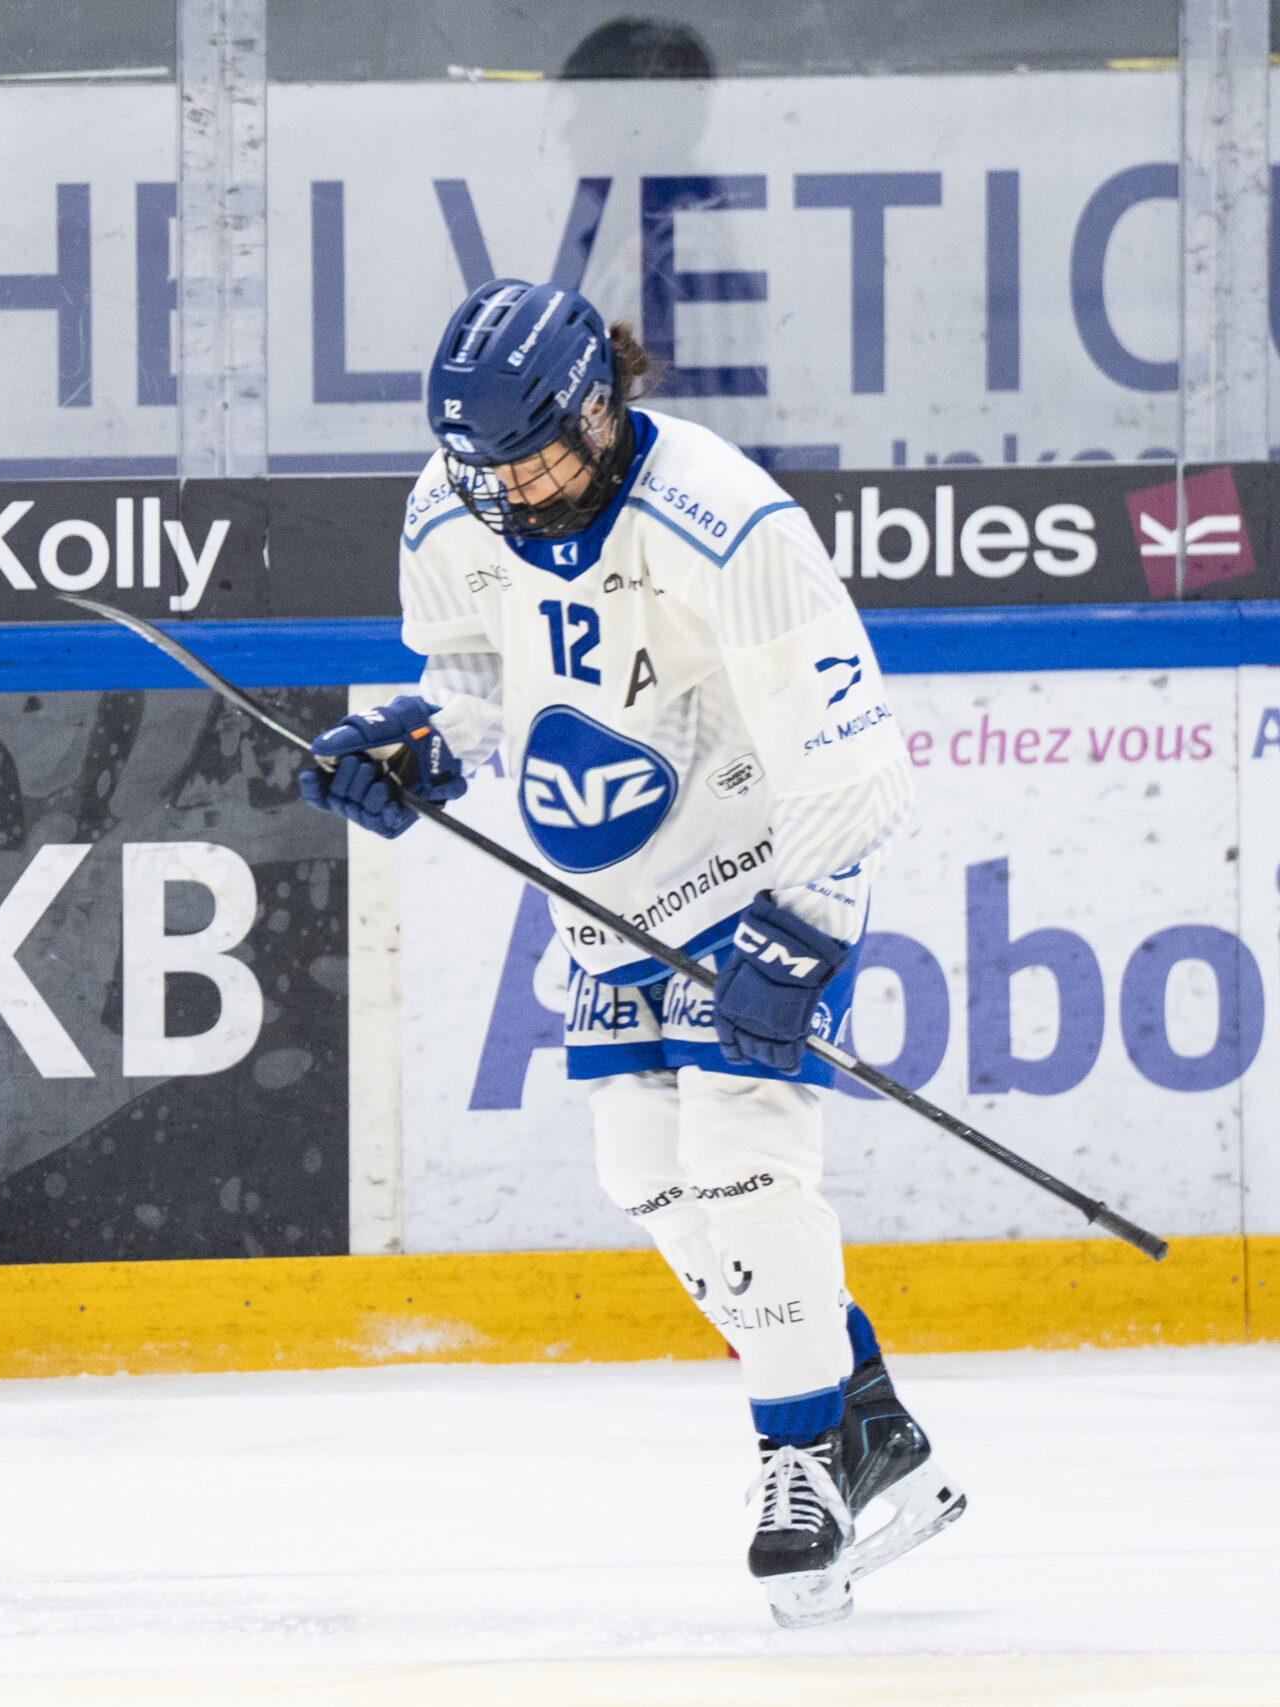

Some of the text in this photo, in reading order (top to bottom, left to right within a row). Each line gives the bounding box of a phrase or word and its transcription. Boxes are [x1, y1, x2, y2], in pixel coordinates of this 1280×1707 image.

[443, 398, 463, 420] 12
[538, 599, 602, 687] 12
[623, 646, 658, 709] A
[949, 712, 1072, 768] chez
[1089, 722, 1213, 763] vous
